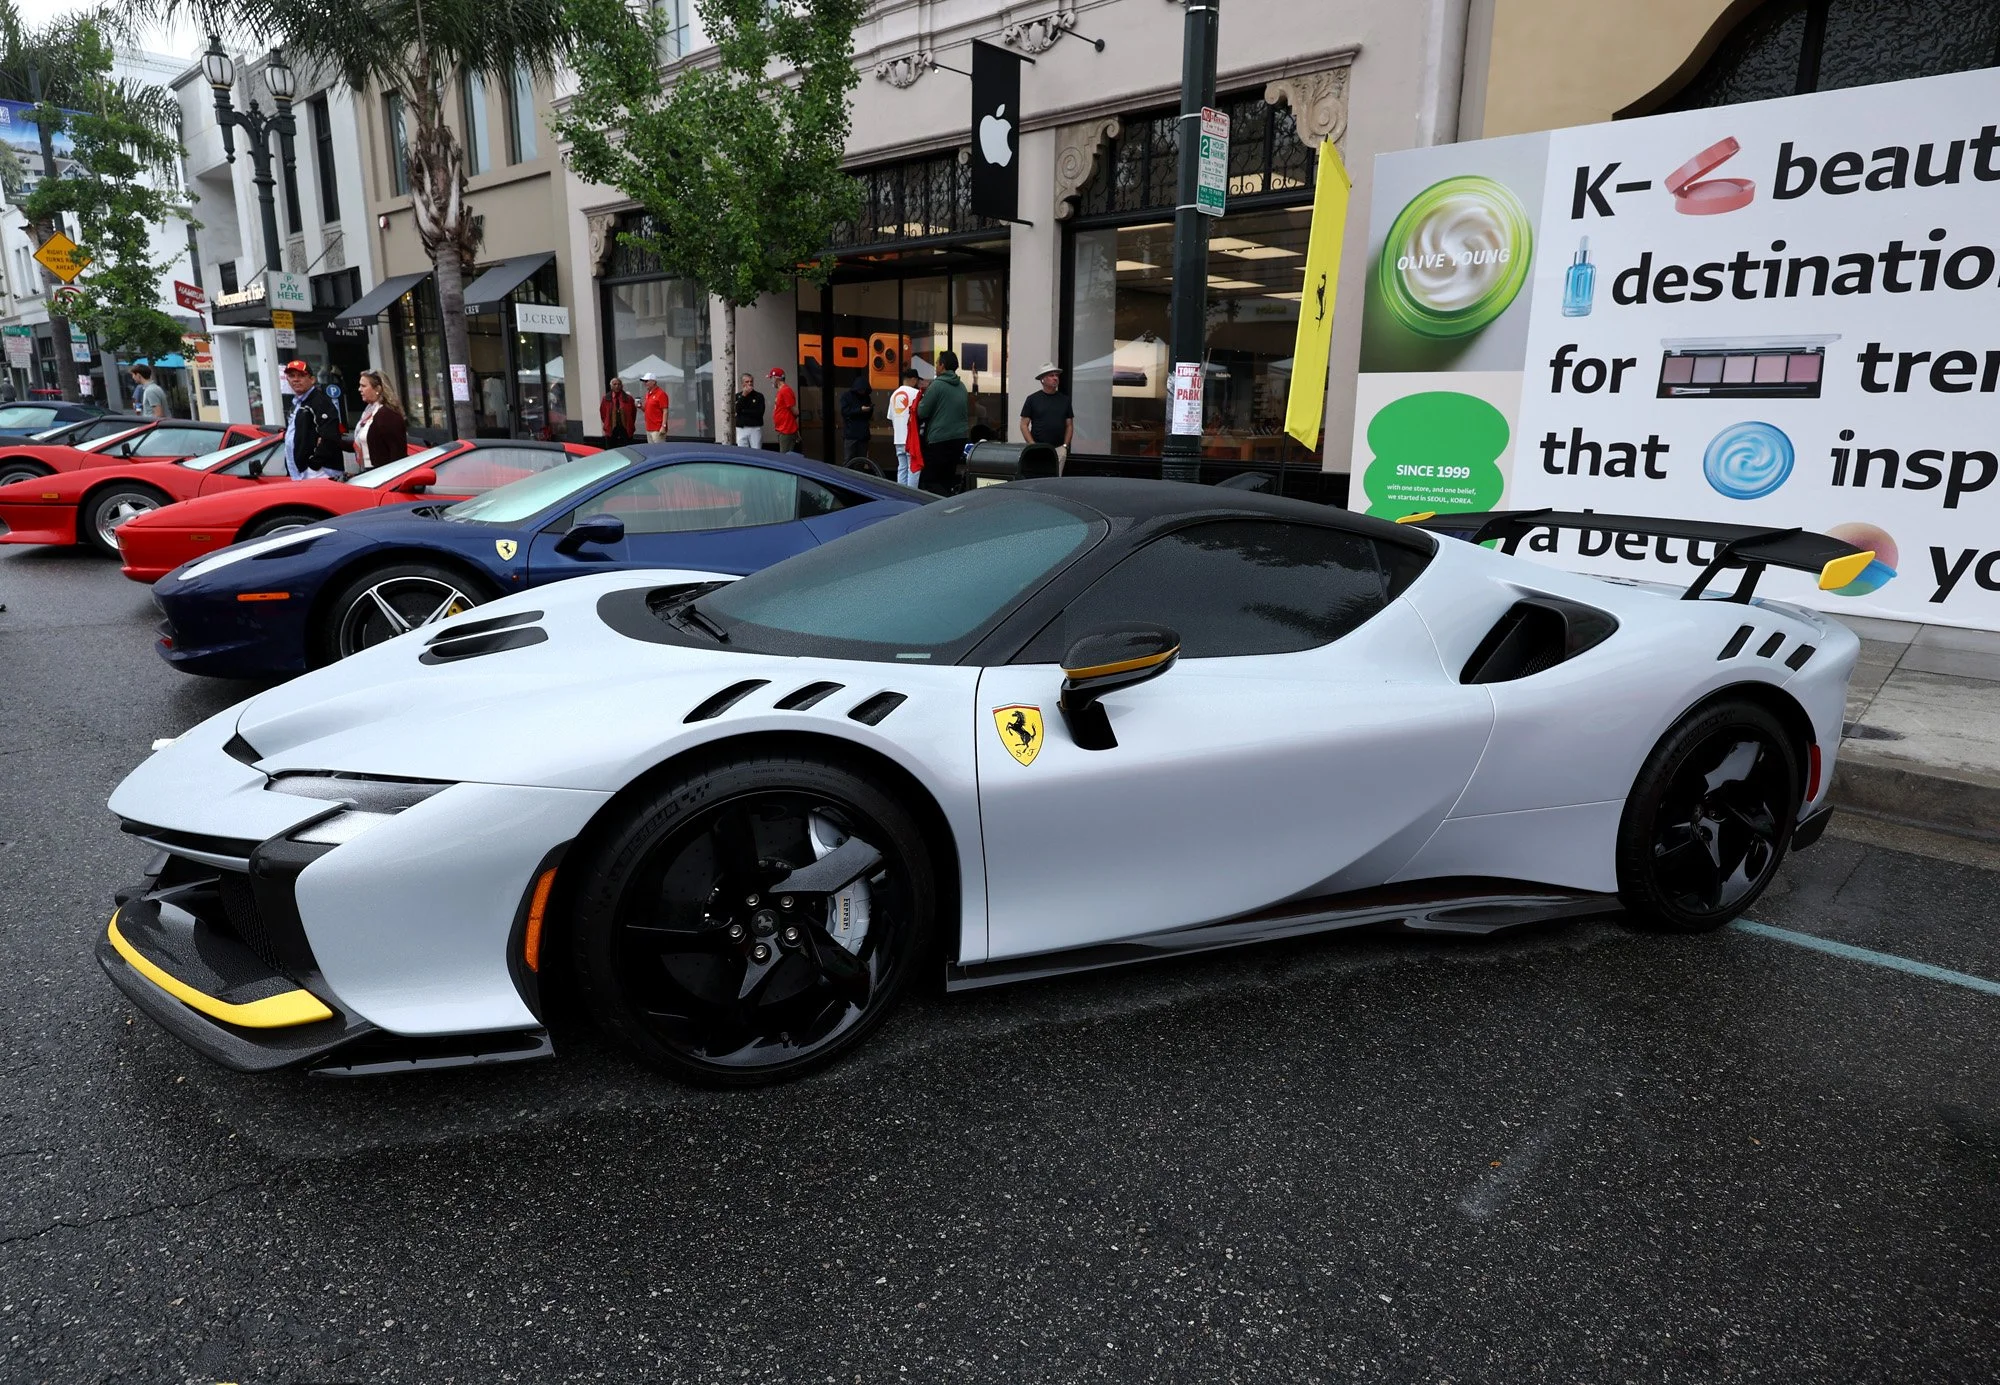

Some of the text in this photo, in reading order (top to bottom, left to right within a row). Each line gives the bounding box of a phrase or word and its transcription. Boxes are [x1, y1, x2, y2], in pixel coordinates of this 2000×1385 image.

[1201, 139, 1209, 156] 2
[1212, 141, 1225, 150] HOUR
[1397, 249, 1510, 271] OLIVE YOUNG
[1612, 228, 2000, 305] destinatio
[277, 291, 305, 300] HERE
[280, 283, 299, 292] PAY
[522, 312, 566, 325] J.CREW
[1549, 343, 1637, 394] for
[1539, 427, 1670, 480] that
[1396, 464, 1470, 479] SINCE 1999
[1427, 496, 1449, 504] SEOUL,
[1450, 497, 1473, 505] KOREA.
[1529, 526, 1559, 553] a
